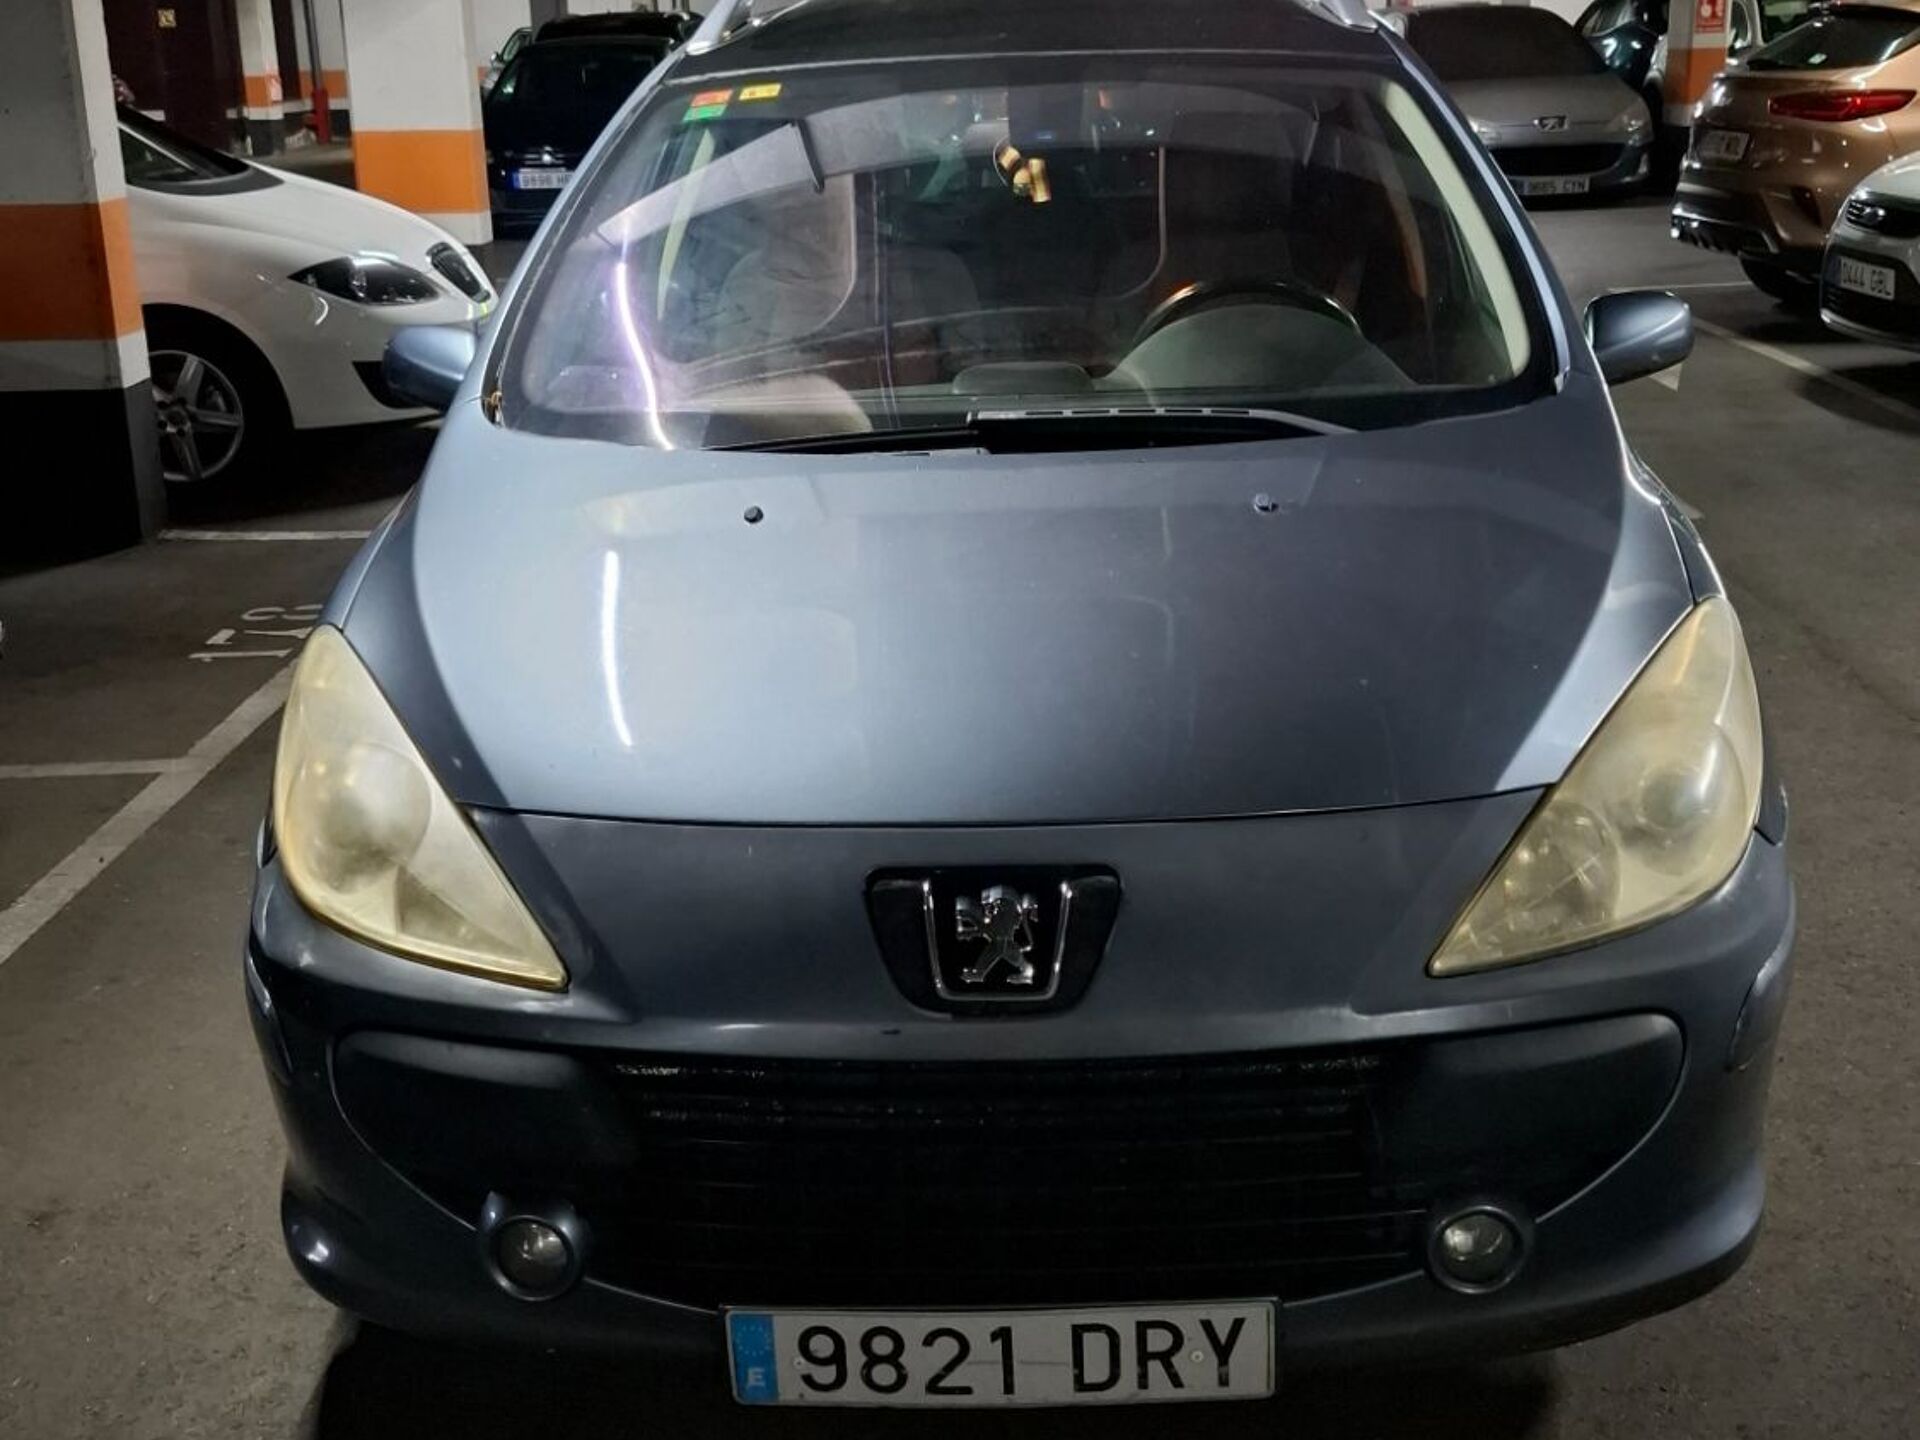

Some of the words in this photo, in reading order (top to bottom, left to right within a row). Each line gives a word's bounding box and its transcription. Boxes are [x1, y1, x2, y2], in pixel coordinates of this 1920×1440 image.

[746, 1367, 766, 1388] E
[797, 1325, 1015, 1396] 9821
[1071, 1317, 1246, 1394] DRY
